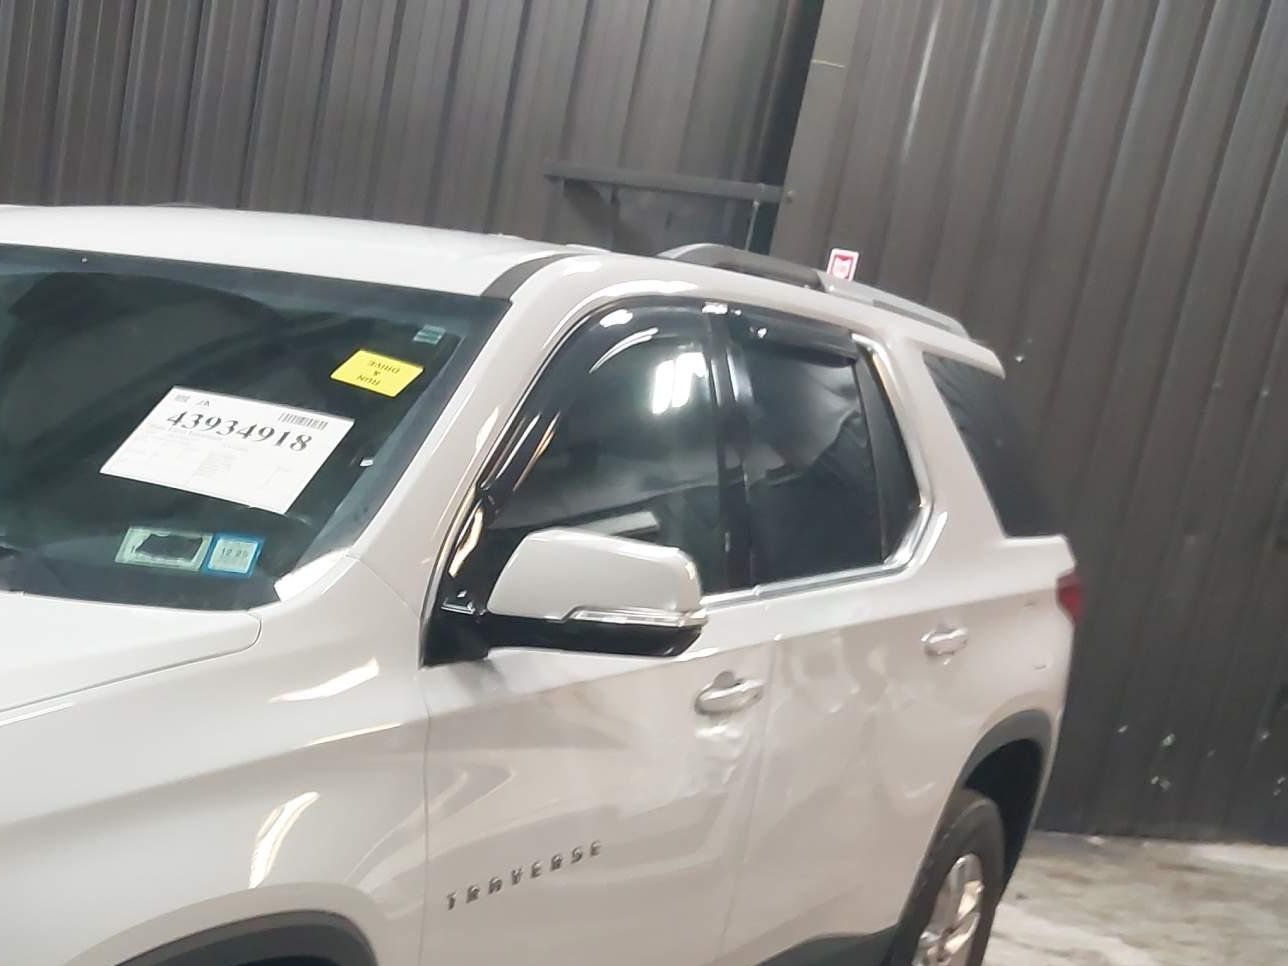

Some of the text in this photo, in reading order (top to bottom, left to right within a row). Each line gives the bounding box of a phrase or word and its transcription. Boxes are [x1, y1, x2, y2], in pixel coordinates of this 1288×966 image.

[367, 360, 401, 374] DRIVE
[166, 410, 313, 452] 43934918
[446, 840, 602, 911] TRAVERSE
